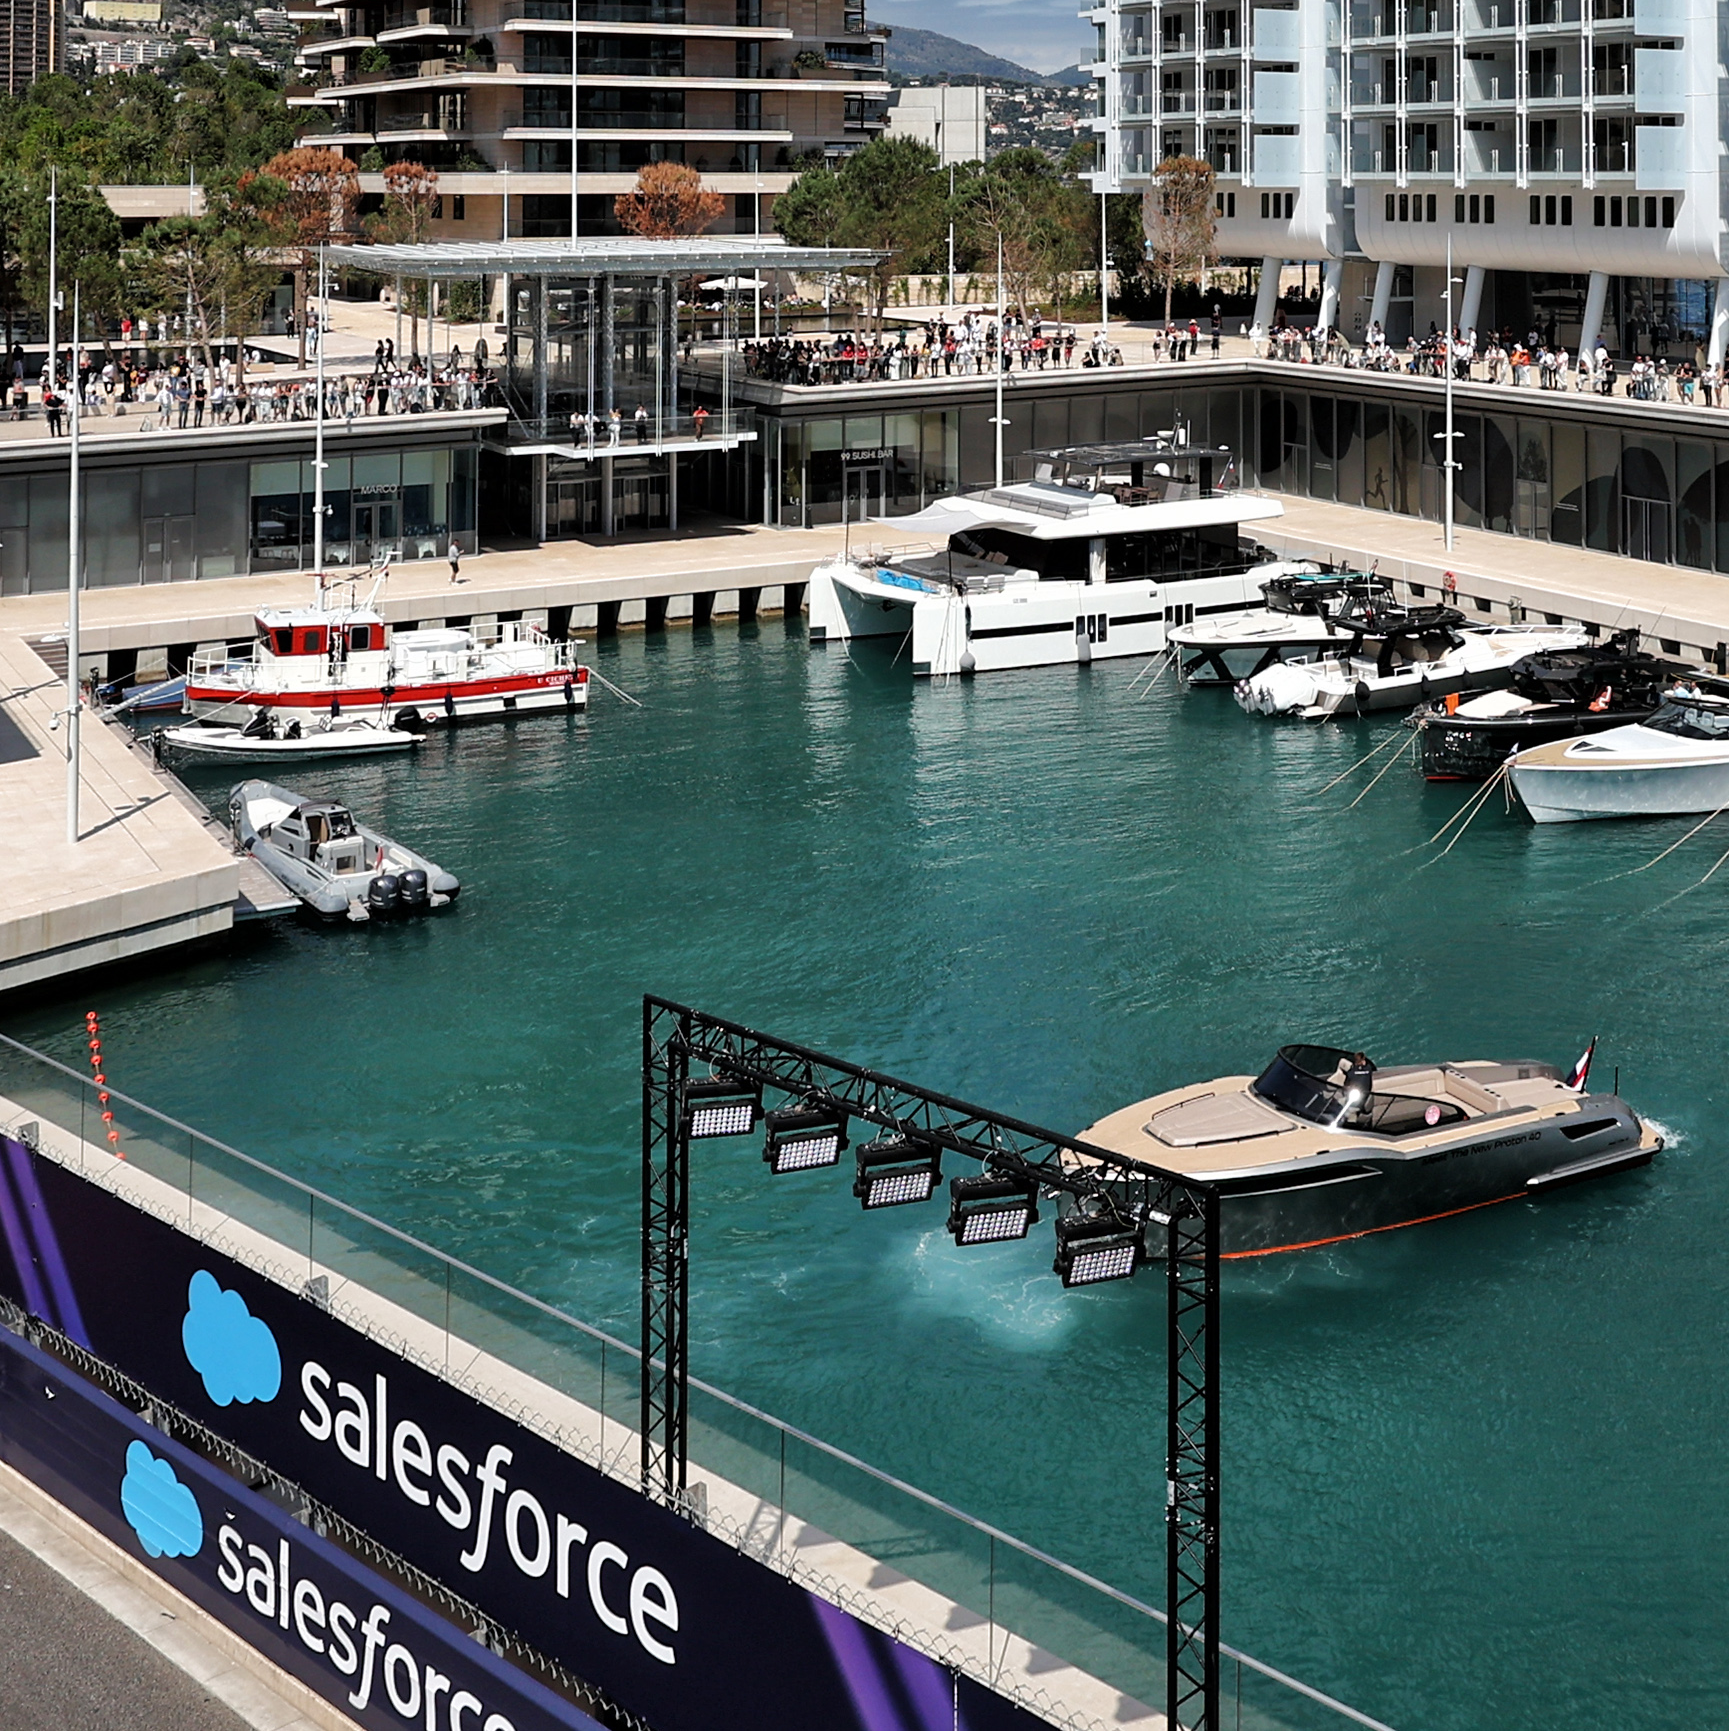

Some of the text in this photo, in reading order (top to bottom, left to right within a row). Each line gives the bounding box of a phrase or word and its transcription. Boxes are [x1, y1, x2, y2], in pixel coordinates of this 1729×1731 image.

[852, 451, 876, 460] SUSHI
[878, 450, 893, 458] BAR
[1471, 1143, 1492, 1155] New
[1494, 1136, 1527, 1149] Proton
[1529, 1132, 1542, 1141] 40
[299, 1361, 679, 1664] salesforce
[217, 1524, 516, 1731] salesforc
